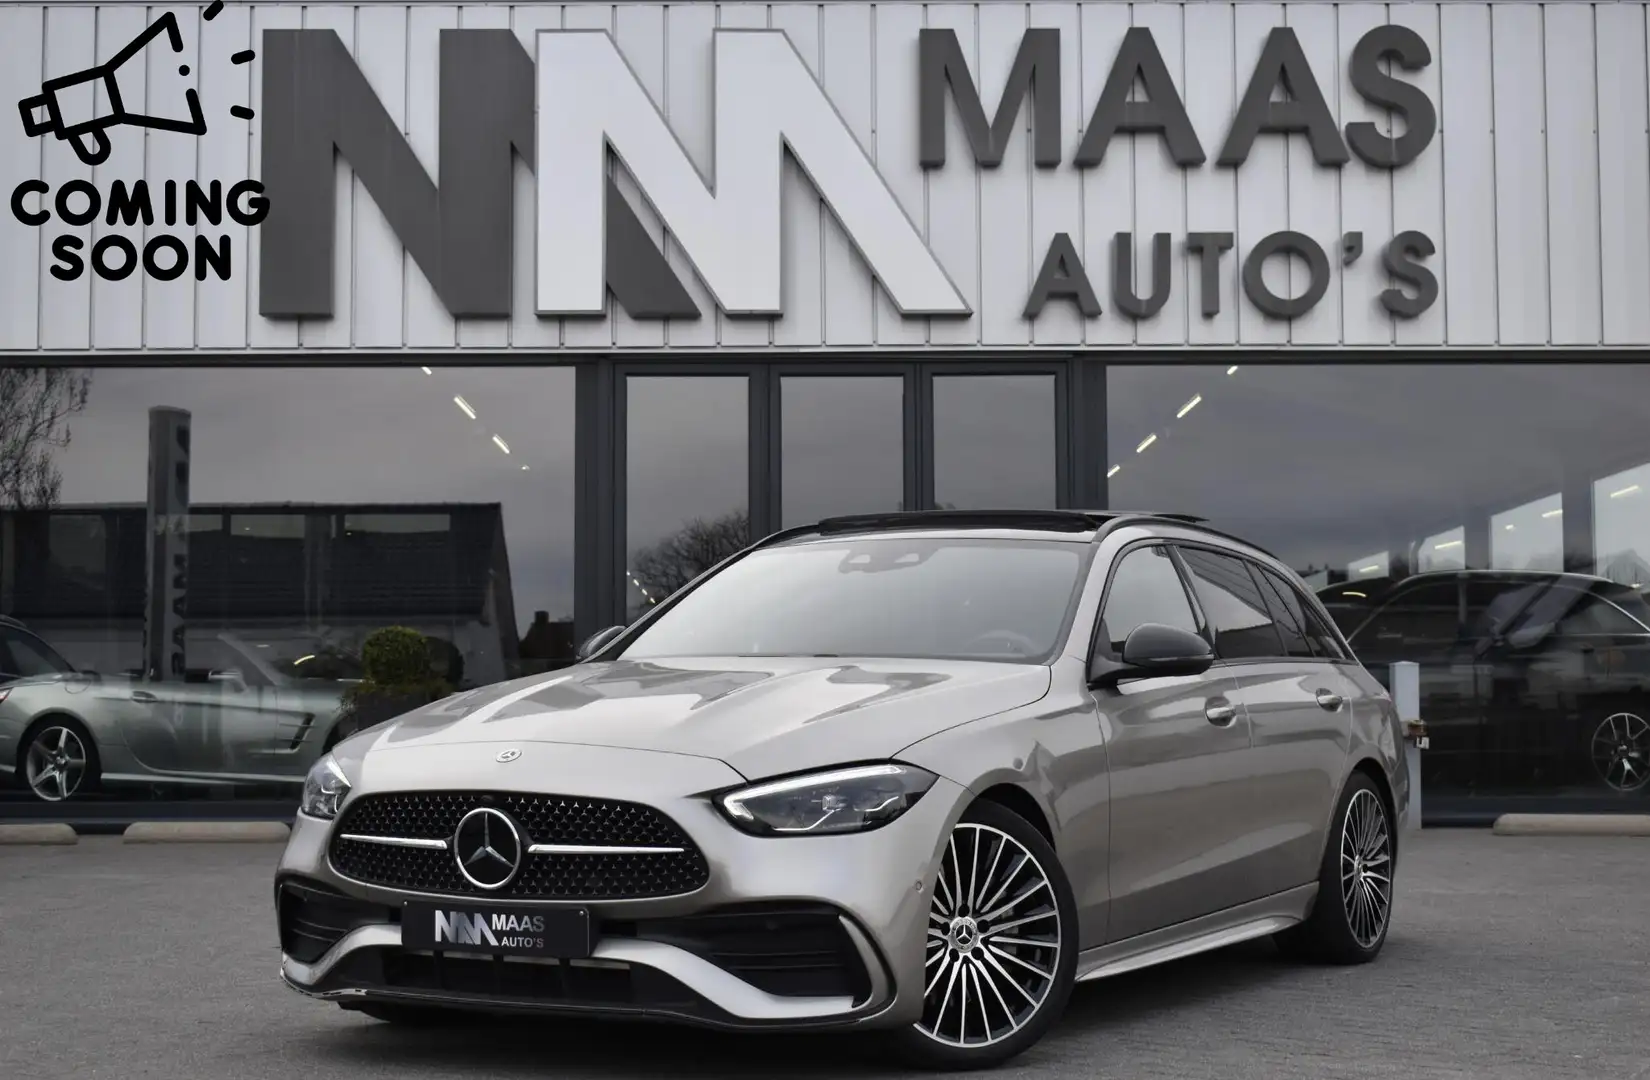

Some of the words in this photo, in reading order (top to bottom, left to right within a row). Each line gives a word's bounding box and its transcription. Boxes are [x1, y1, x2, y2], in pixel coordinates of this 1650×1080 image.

[918, 24, 1437, 169] MAAS
[1022, 230, 1439, 319] AUTO'S
[491, 913, 545, 932] MAAS
[501, 936, 544, 948] AUTO'S
